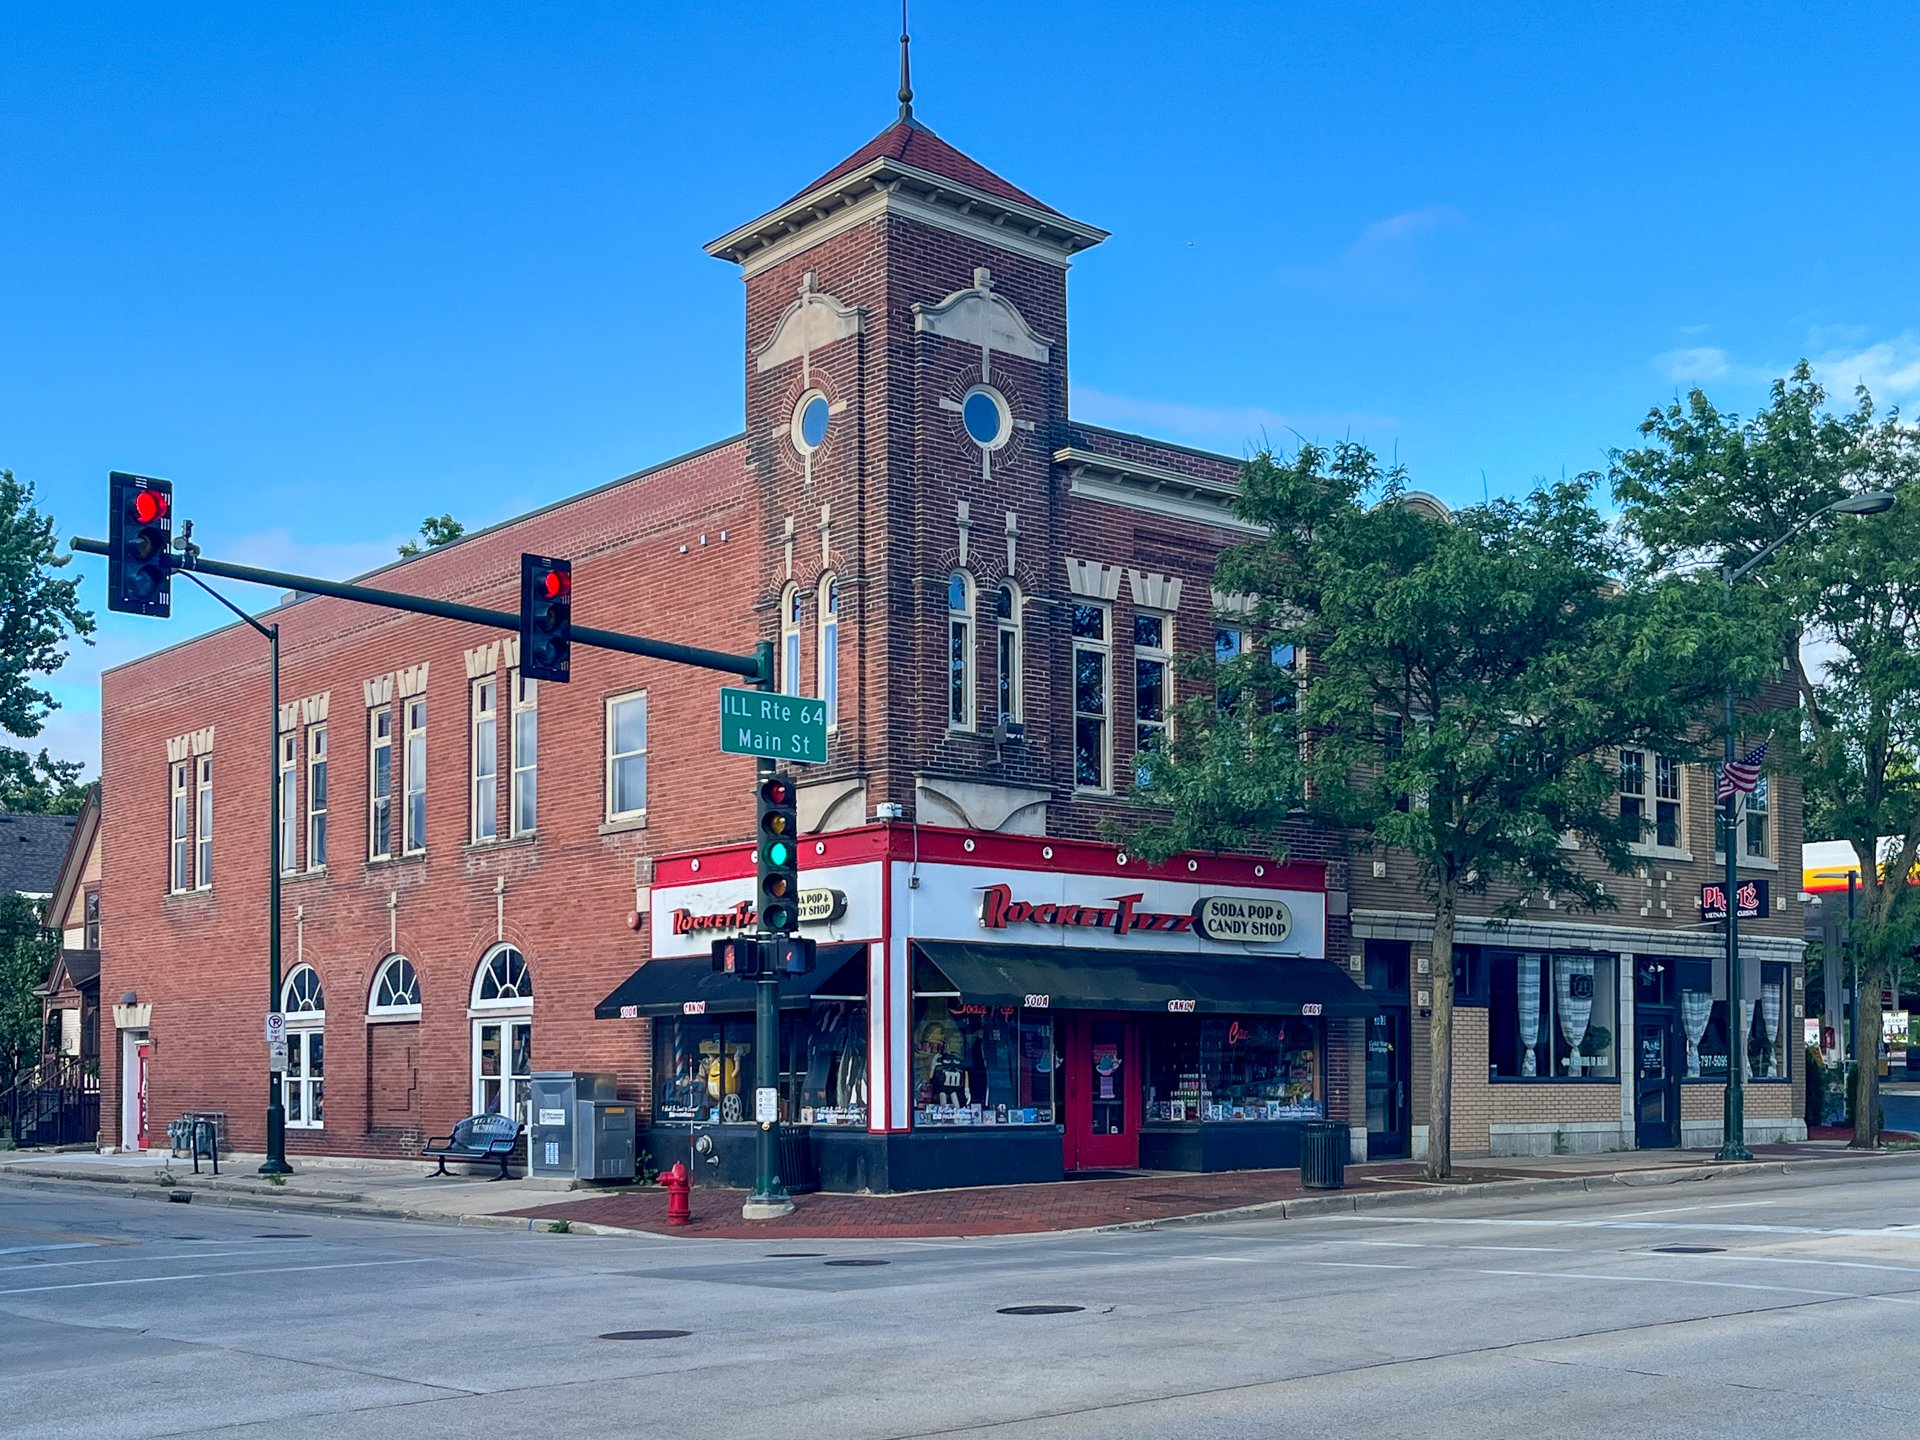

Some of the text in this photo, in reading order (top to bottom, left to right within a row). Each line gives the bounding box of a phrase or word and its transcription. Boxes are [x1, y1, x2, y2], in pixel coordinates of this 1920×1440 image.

[724, 695, 824, 726] ILL Rte 64
[739, 728, 810, 754] Main St
[806, 893, 822, 904] POP
[823, 894, 828, 902] &
[809, 904, 830, 915] SHOP
[1211, 903, 1283, 920] SODA POP &
[1737, 909, 1757, 917] CUISINE
[1208, 918, 1286, 936] CANDY SHOP
[684, 1001, 706, 1014] CANDY
[1024, 994, 1050, 1008] SODA
[1168, 1000, 1196, 1012] CANDY
[620, 1006, 638, 1018] SODA
